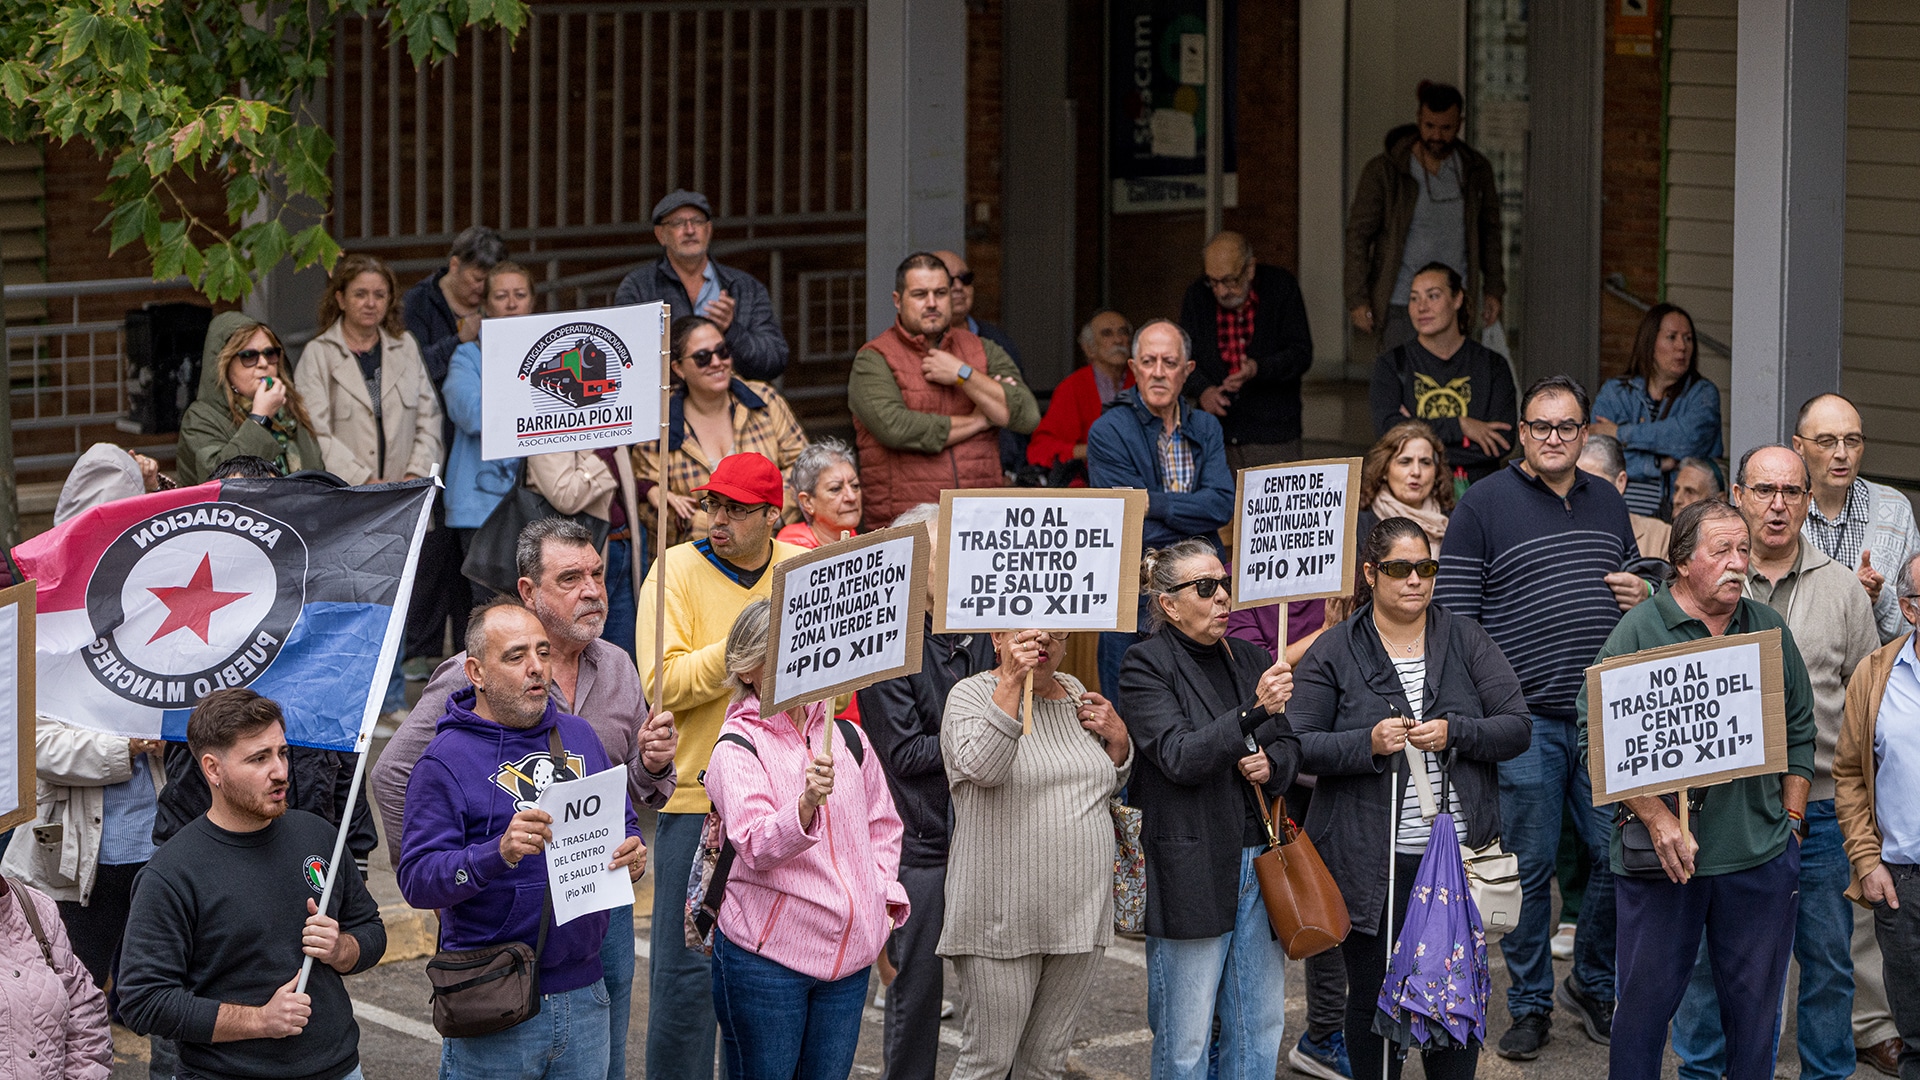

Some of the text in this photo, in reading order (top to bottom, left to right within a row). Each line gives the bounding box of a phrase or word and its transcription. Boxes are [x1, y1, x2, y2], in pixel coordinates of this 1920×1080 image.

[523, 324, 629, 374] ANTIGUA COOPERATIVA FERROVIARIA
[517, 412, 586, 432] BARRIADA
[616, 406, 632, 422] XII
[518, 435, 576, 447] ASOCIACIÓN
[593, 428, 632, 439] VECINOS
[1264, 473, 1324, 494] CENTRO DE
[1247, 488, 1342, 516] SALUD, ATENCIÓN
[1006, 507, 1068, 527] NO AL
[1254, 510, 1332, 534] CONTINUADA Y
[958, 528, 1114, 550] TRASLADO DEL
[1250, 530, 1334, 554] ZONA VERDE EN
[810, 550, 884, 587] CENTRO DE
[992, 551, 1077, 572] CENTRO
[1247, 554, 1335, 581] “PÍO XII”
[788, 563, 905, 615] SALUD, ATENCIÓN
[971, 572, 1094, 594] DE SALUD 1
[795, 586, 895, 631] CONTINUADA Y
[1044, 594, 1107, 615] XII”
[791, 605, 896, 653] ZONA VERDE EN
[786, 629, 898, 678] “PÍO XII”
[1650, 661, 1708, 689] NO AL
[1610, 673, 1753, 720] TRASLADO DEL
[1641, 700, 1720, 732] CENTRO
[1625, 715, 1738, 757] DE SALUD 1
[1695, 734, 1753, 763] XII”
[564, 795, 601, 823] NO
[550, 828, 609, 851] AL TRASLADO
[554, 845, 605, 867] DEL CENTRO
[559, 863, 605, 884] DE SALUD 1
[582, 882, 596, 893] XII)
